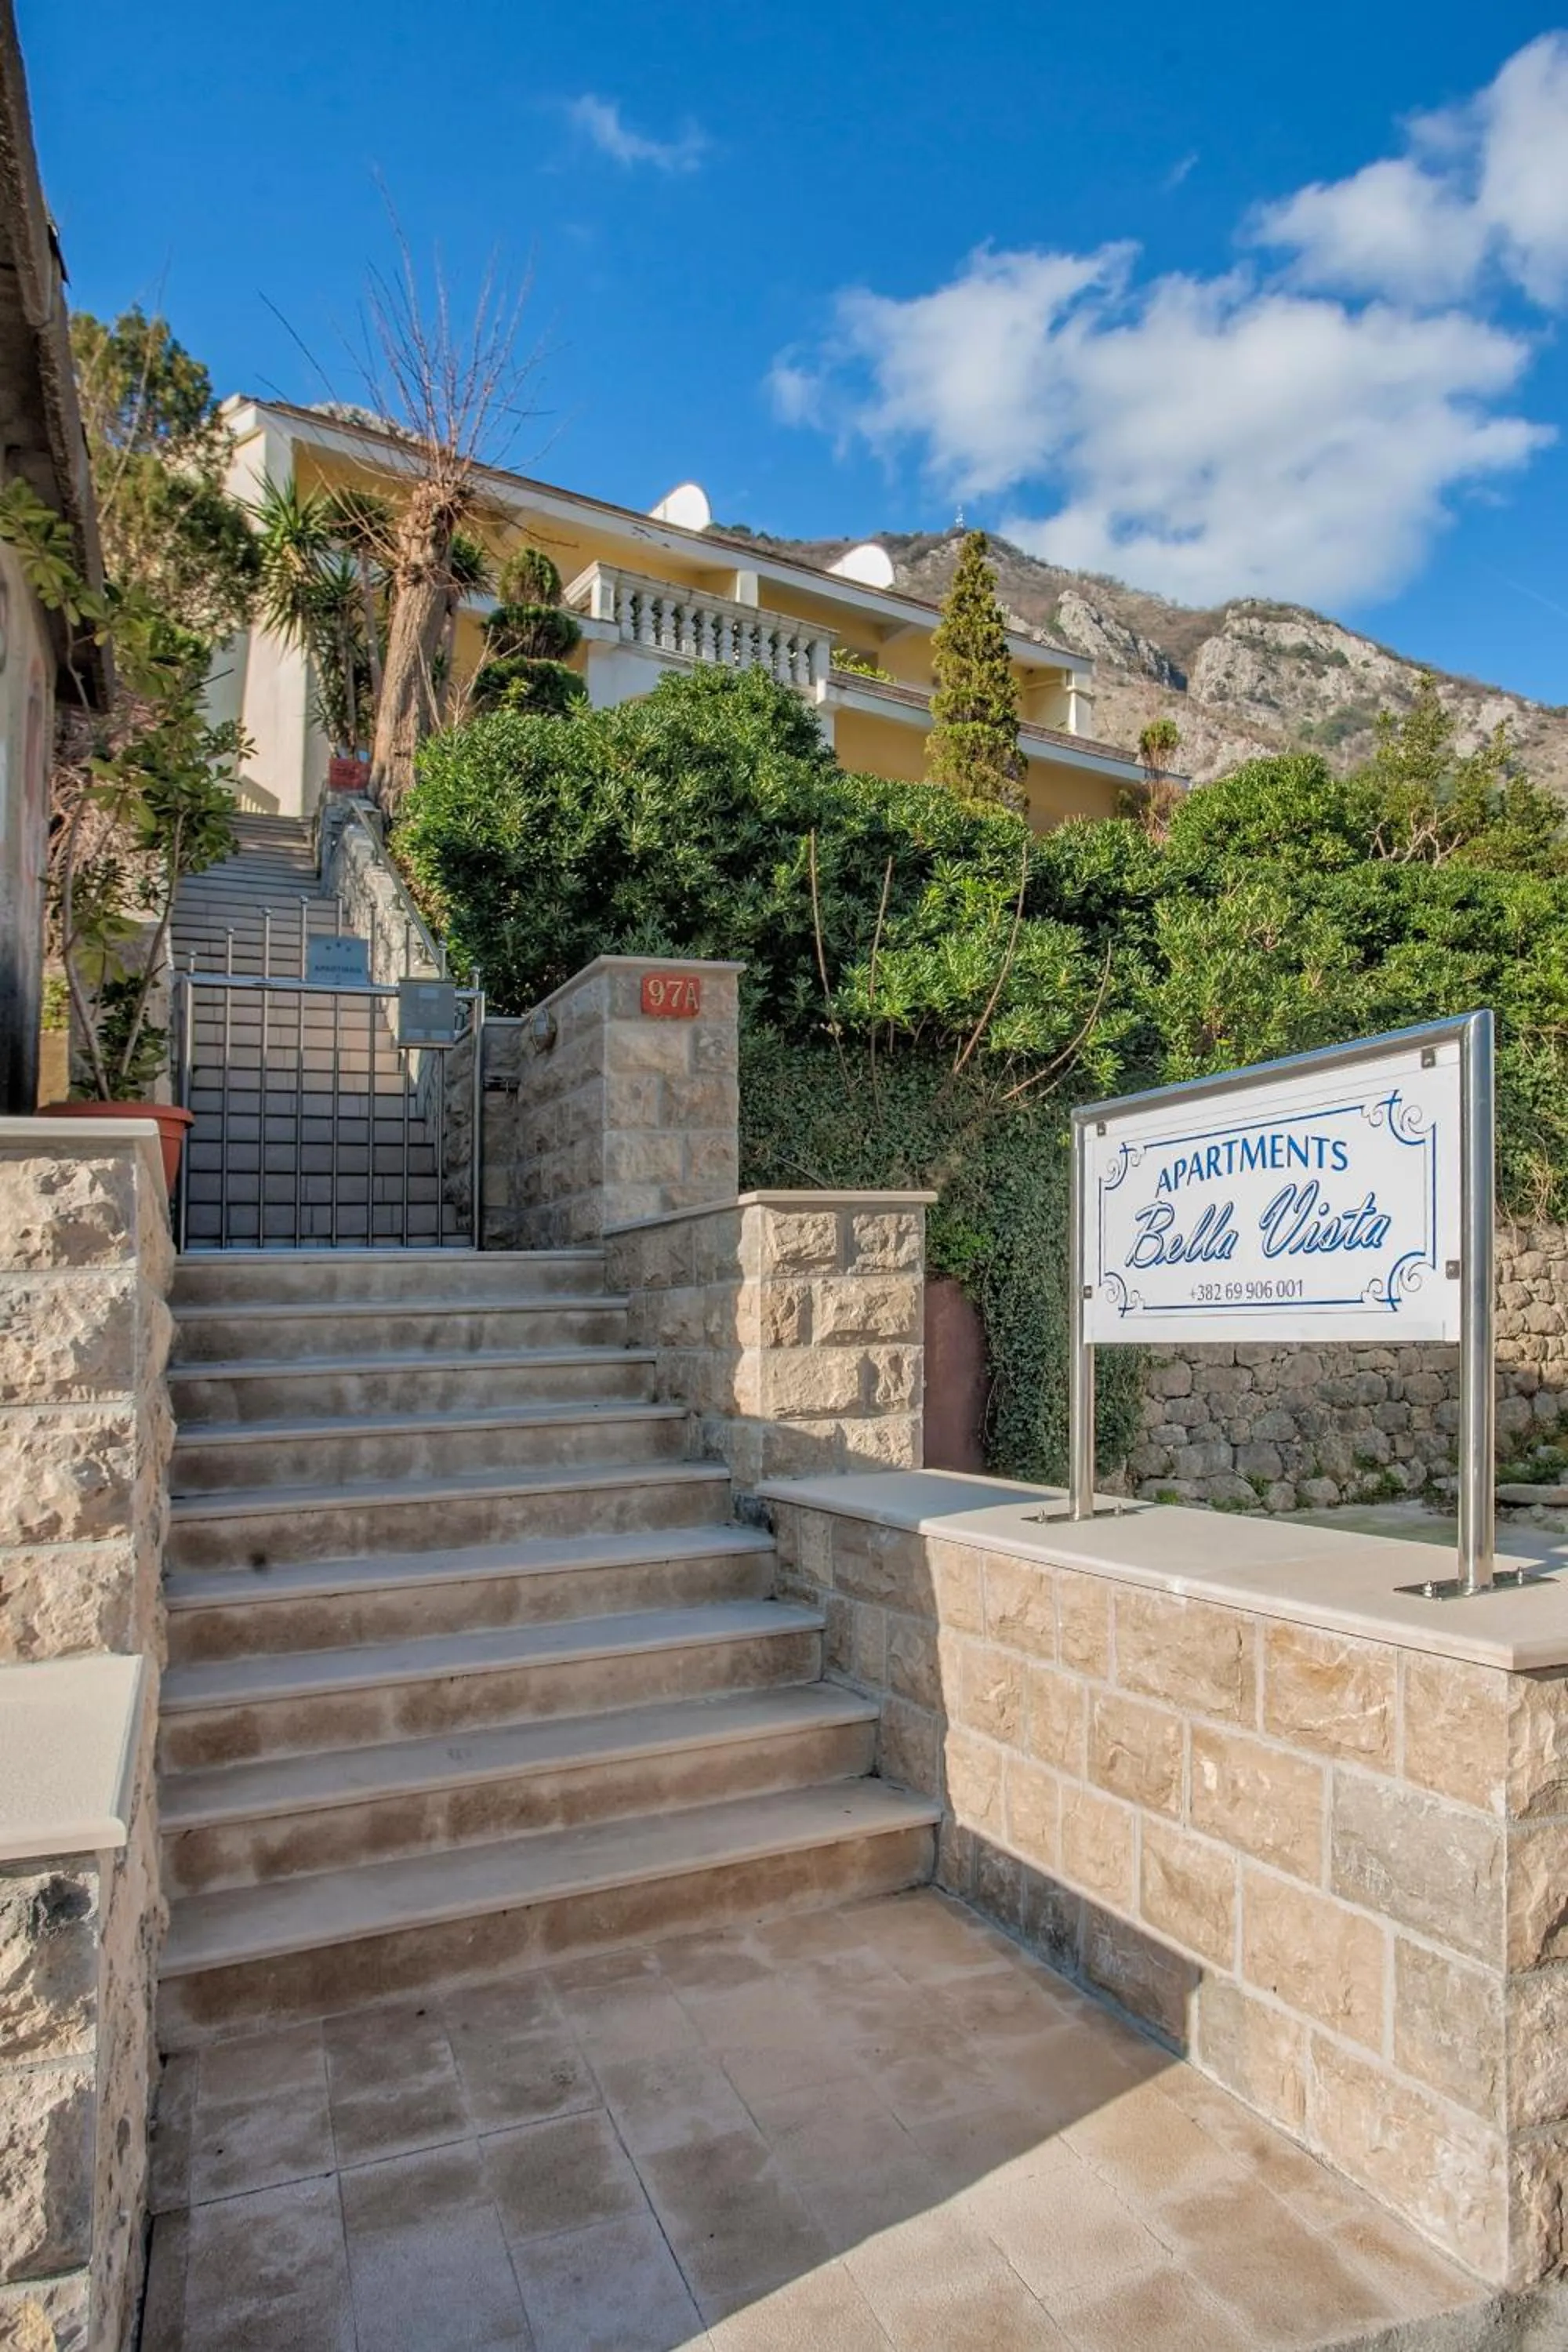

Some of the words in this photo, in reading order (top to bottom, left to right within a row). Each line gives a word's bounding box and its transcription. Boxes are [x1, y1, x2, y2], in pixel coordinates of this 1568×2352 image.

[648, 979, 699, 1010] 97A
[1155, 1134, 1348, 1199] APARTMENTS
[1124, 1200, 1239, 1269] Bella
[1258, 1179, 1392, 1258] Vista
[1190, 1283, 1221, 1301] +382
[1225, 1282, 1243, 1300] 69
[1245, 1280, 1272, 1299] 906
[1276, 1279, 1303, 1298] 001
